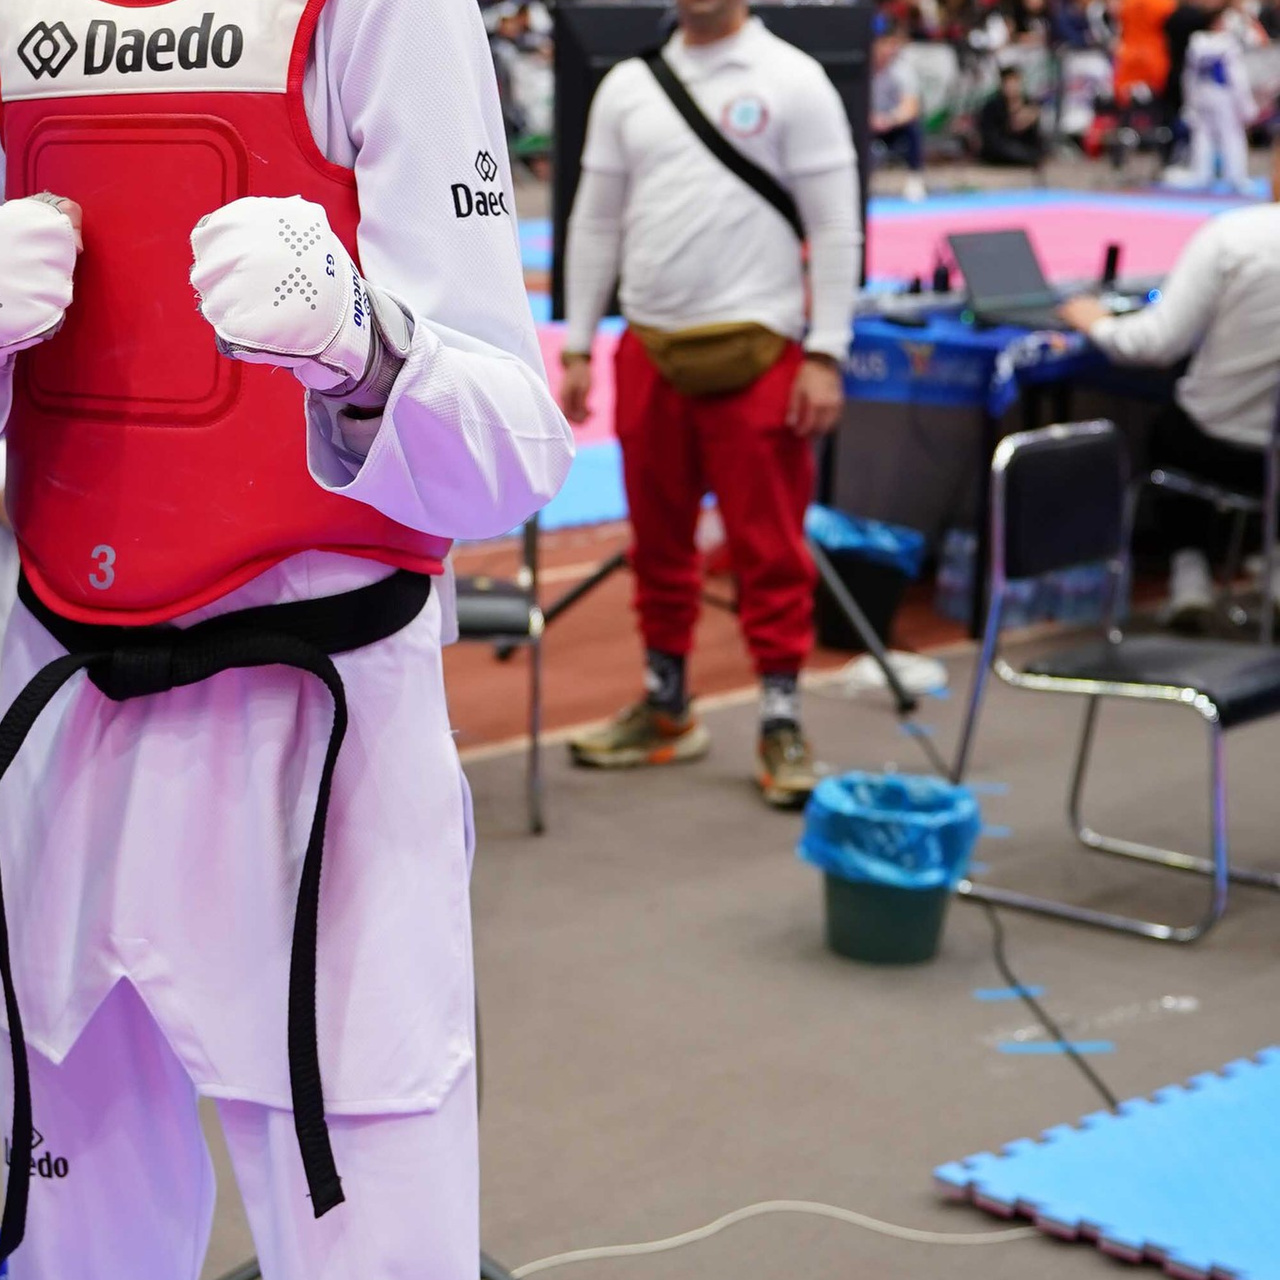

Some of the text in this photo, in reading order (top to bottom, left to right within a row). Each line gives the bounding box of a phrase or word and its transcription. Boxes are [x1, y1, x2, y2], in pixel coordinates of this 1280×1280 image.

[83, 12, 244, 76] Daedo
[325, 253, 336, 278] G3
[88, 544, 117, 590] 3
